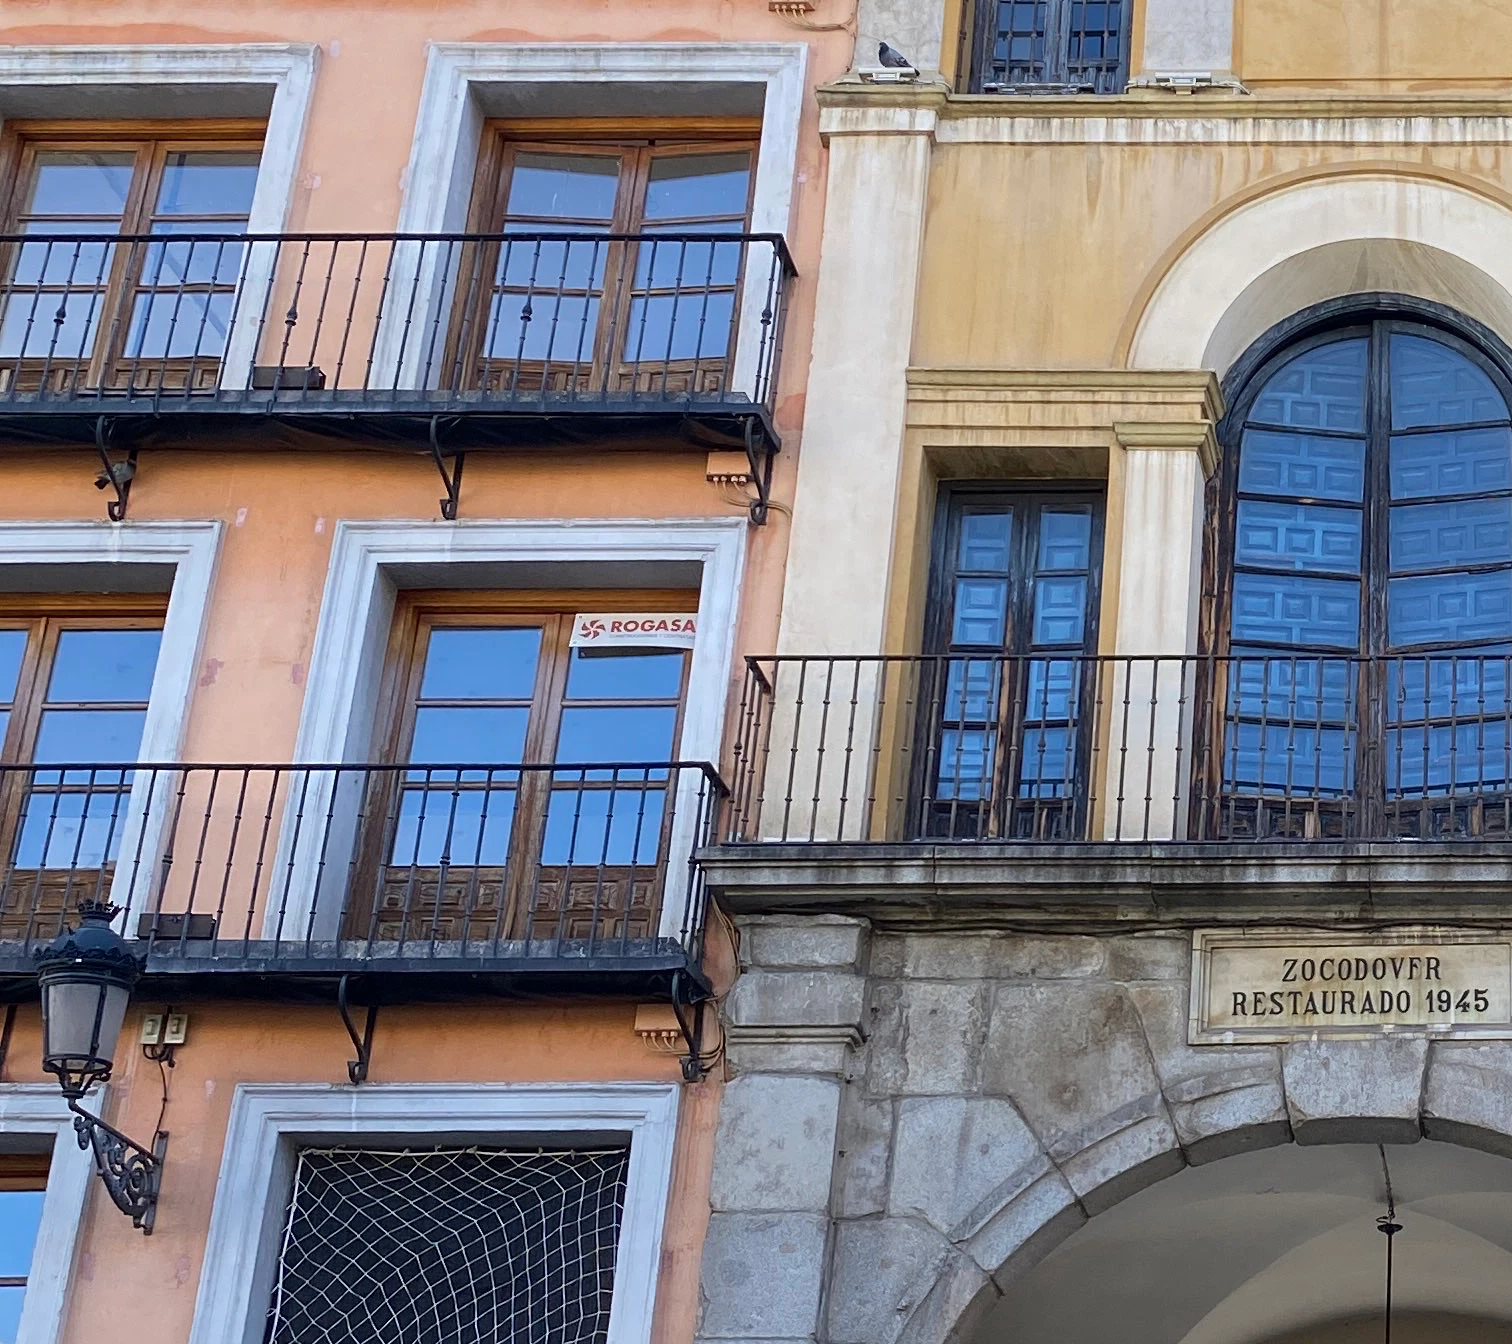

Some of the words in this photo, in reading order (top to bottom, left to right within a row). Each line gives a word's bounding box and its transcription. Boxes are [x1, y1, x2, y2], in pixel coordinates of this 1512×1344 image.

[610, 619, 696, 633] ROGASA
[1231, 990, 1411, 1016] RESTAURADO
[1426, 988, 1489, 1013] 1945
